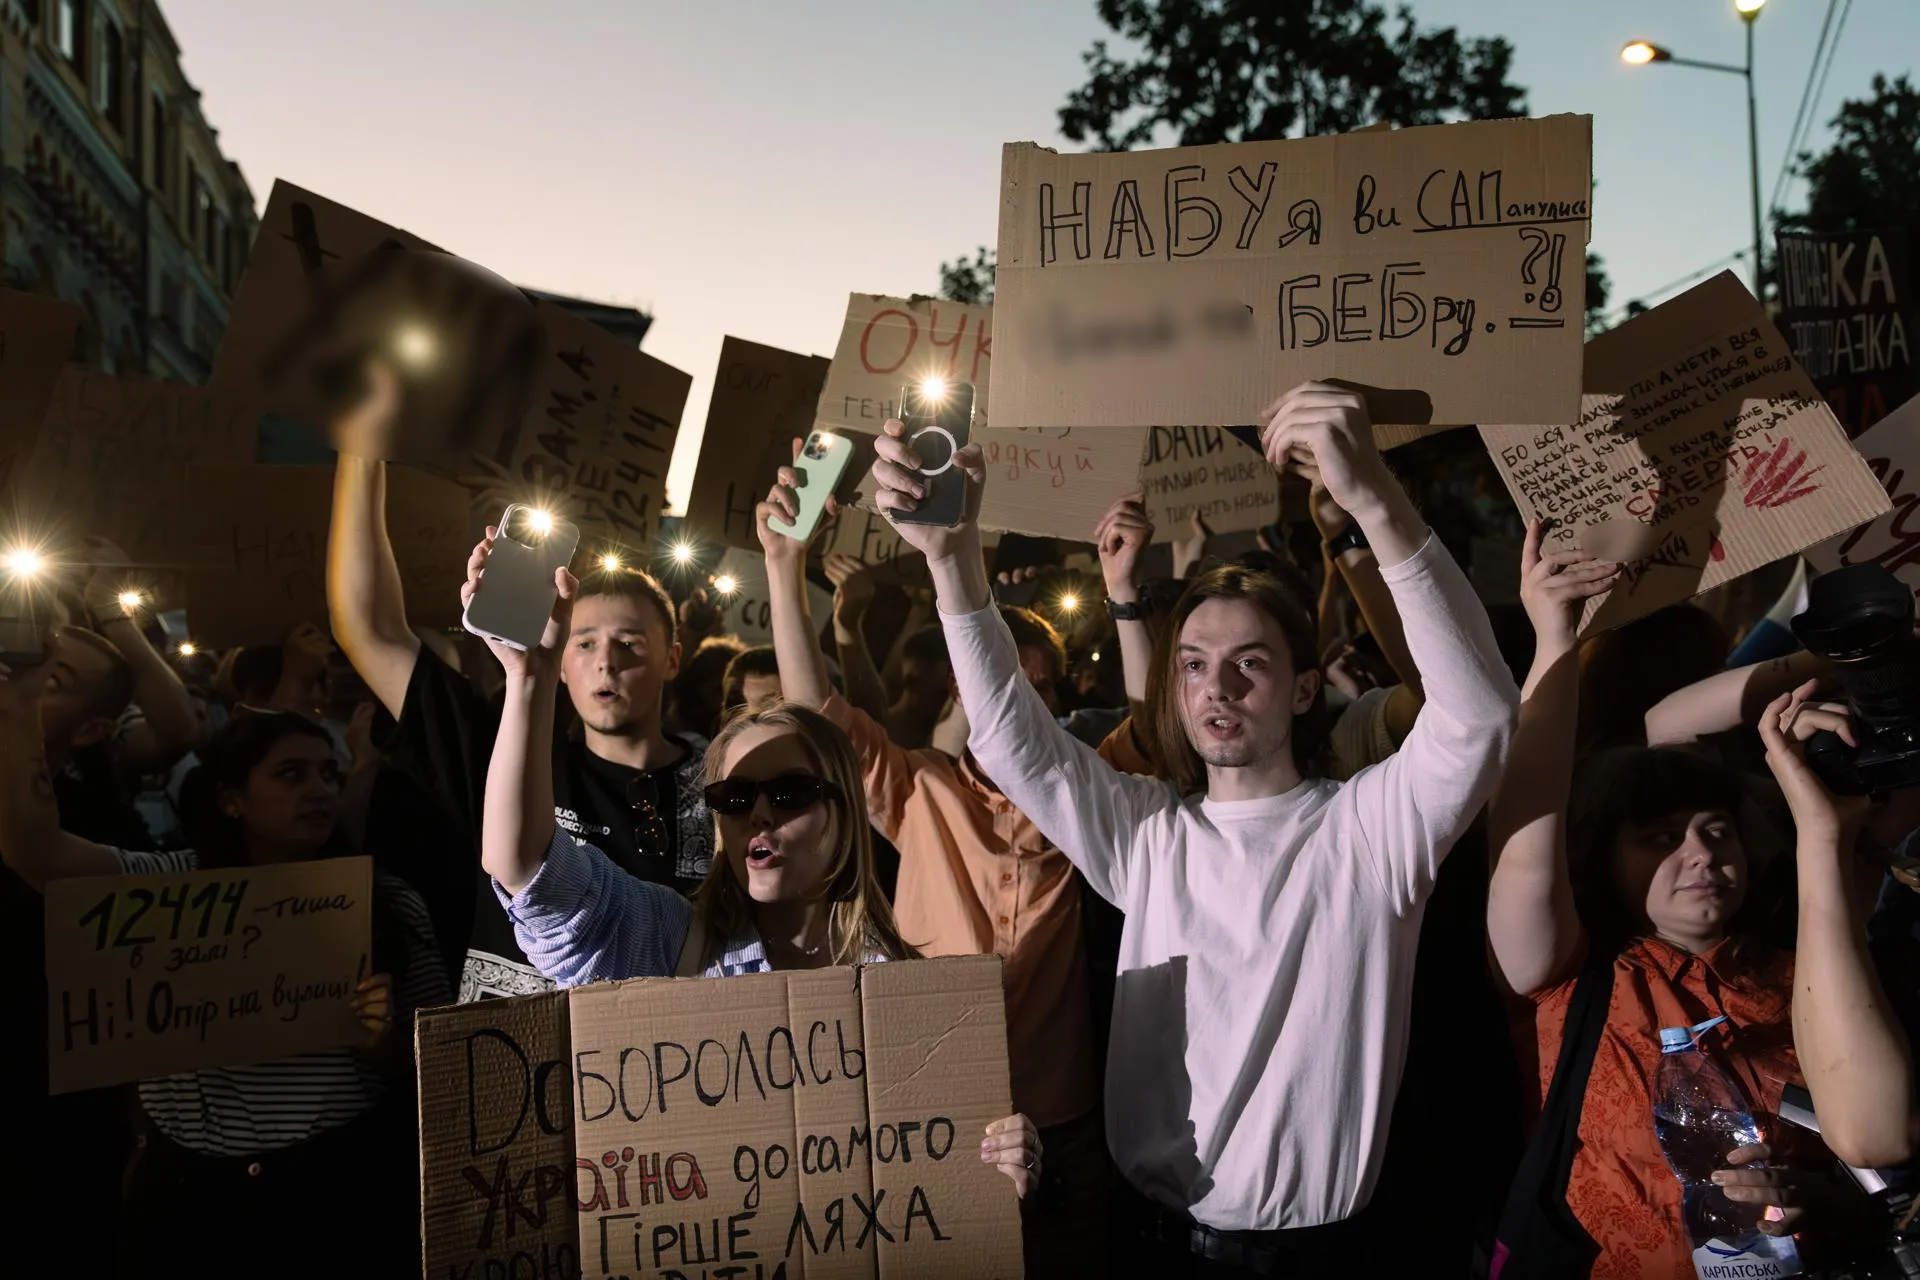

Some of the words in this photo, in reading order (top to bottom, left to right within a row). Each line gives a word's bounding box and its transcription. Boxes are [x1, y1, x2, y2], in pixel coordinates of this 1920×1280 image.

[1501, 444, 1528, 468] БО
[1727, 327, 1761, 351] ВСЯ
[79, 879, 249, 951] 12414
[785, 1185, 952, 1258] ЛЯХА
[1702, 1262, 1781, 1280] КАРПАТСЬКА
